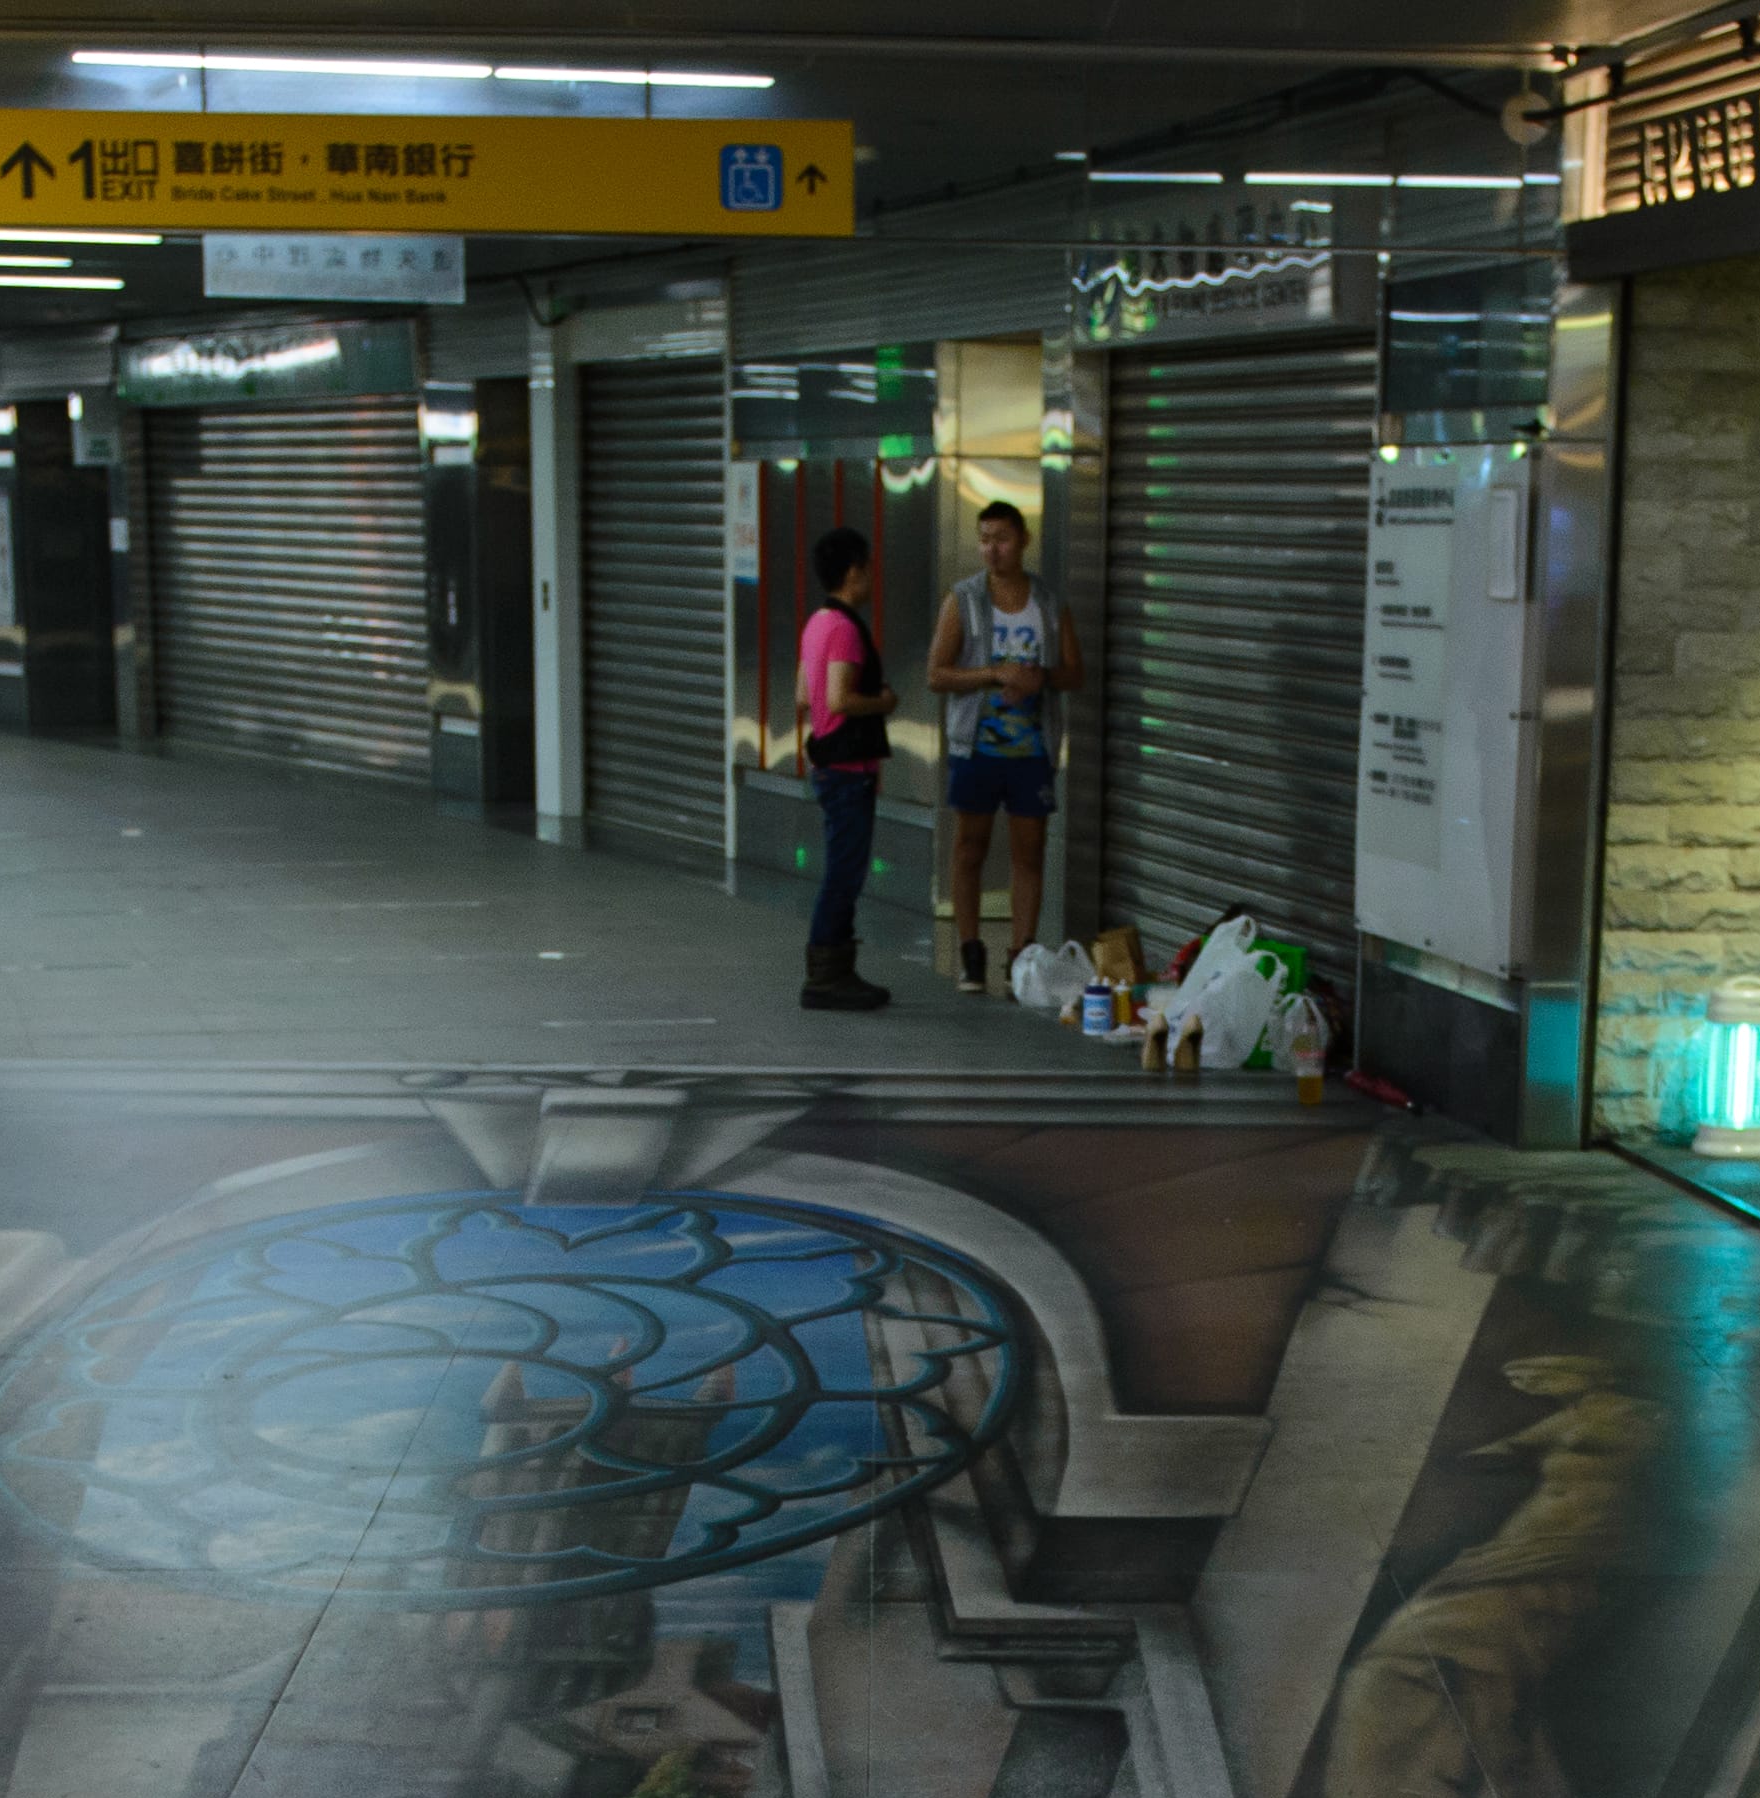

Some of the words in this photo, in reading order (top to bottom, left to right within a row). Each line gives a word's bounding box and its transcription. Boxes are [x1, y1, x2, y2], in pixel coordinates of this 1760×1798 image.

[68, 139, 99, 199] 1
[100, 139, 160, 176] 出口
[100, 180, 159, 201] EXIT
